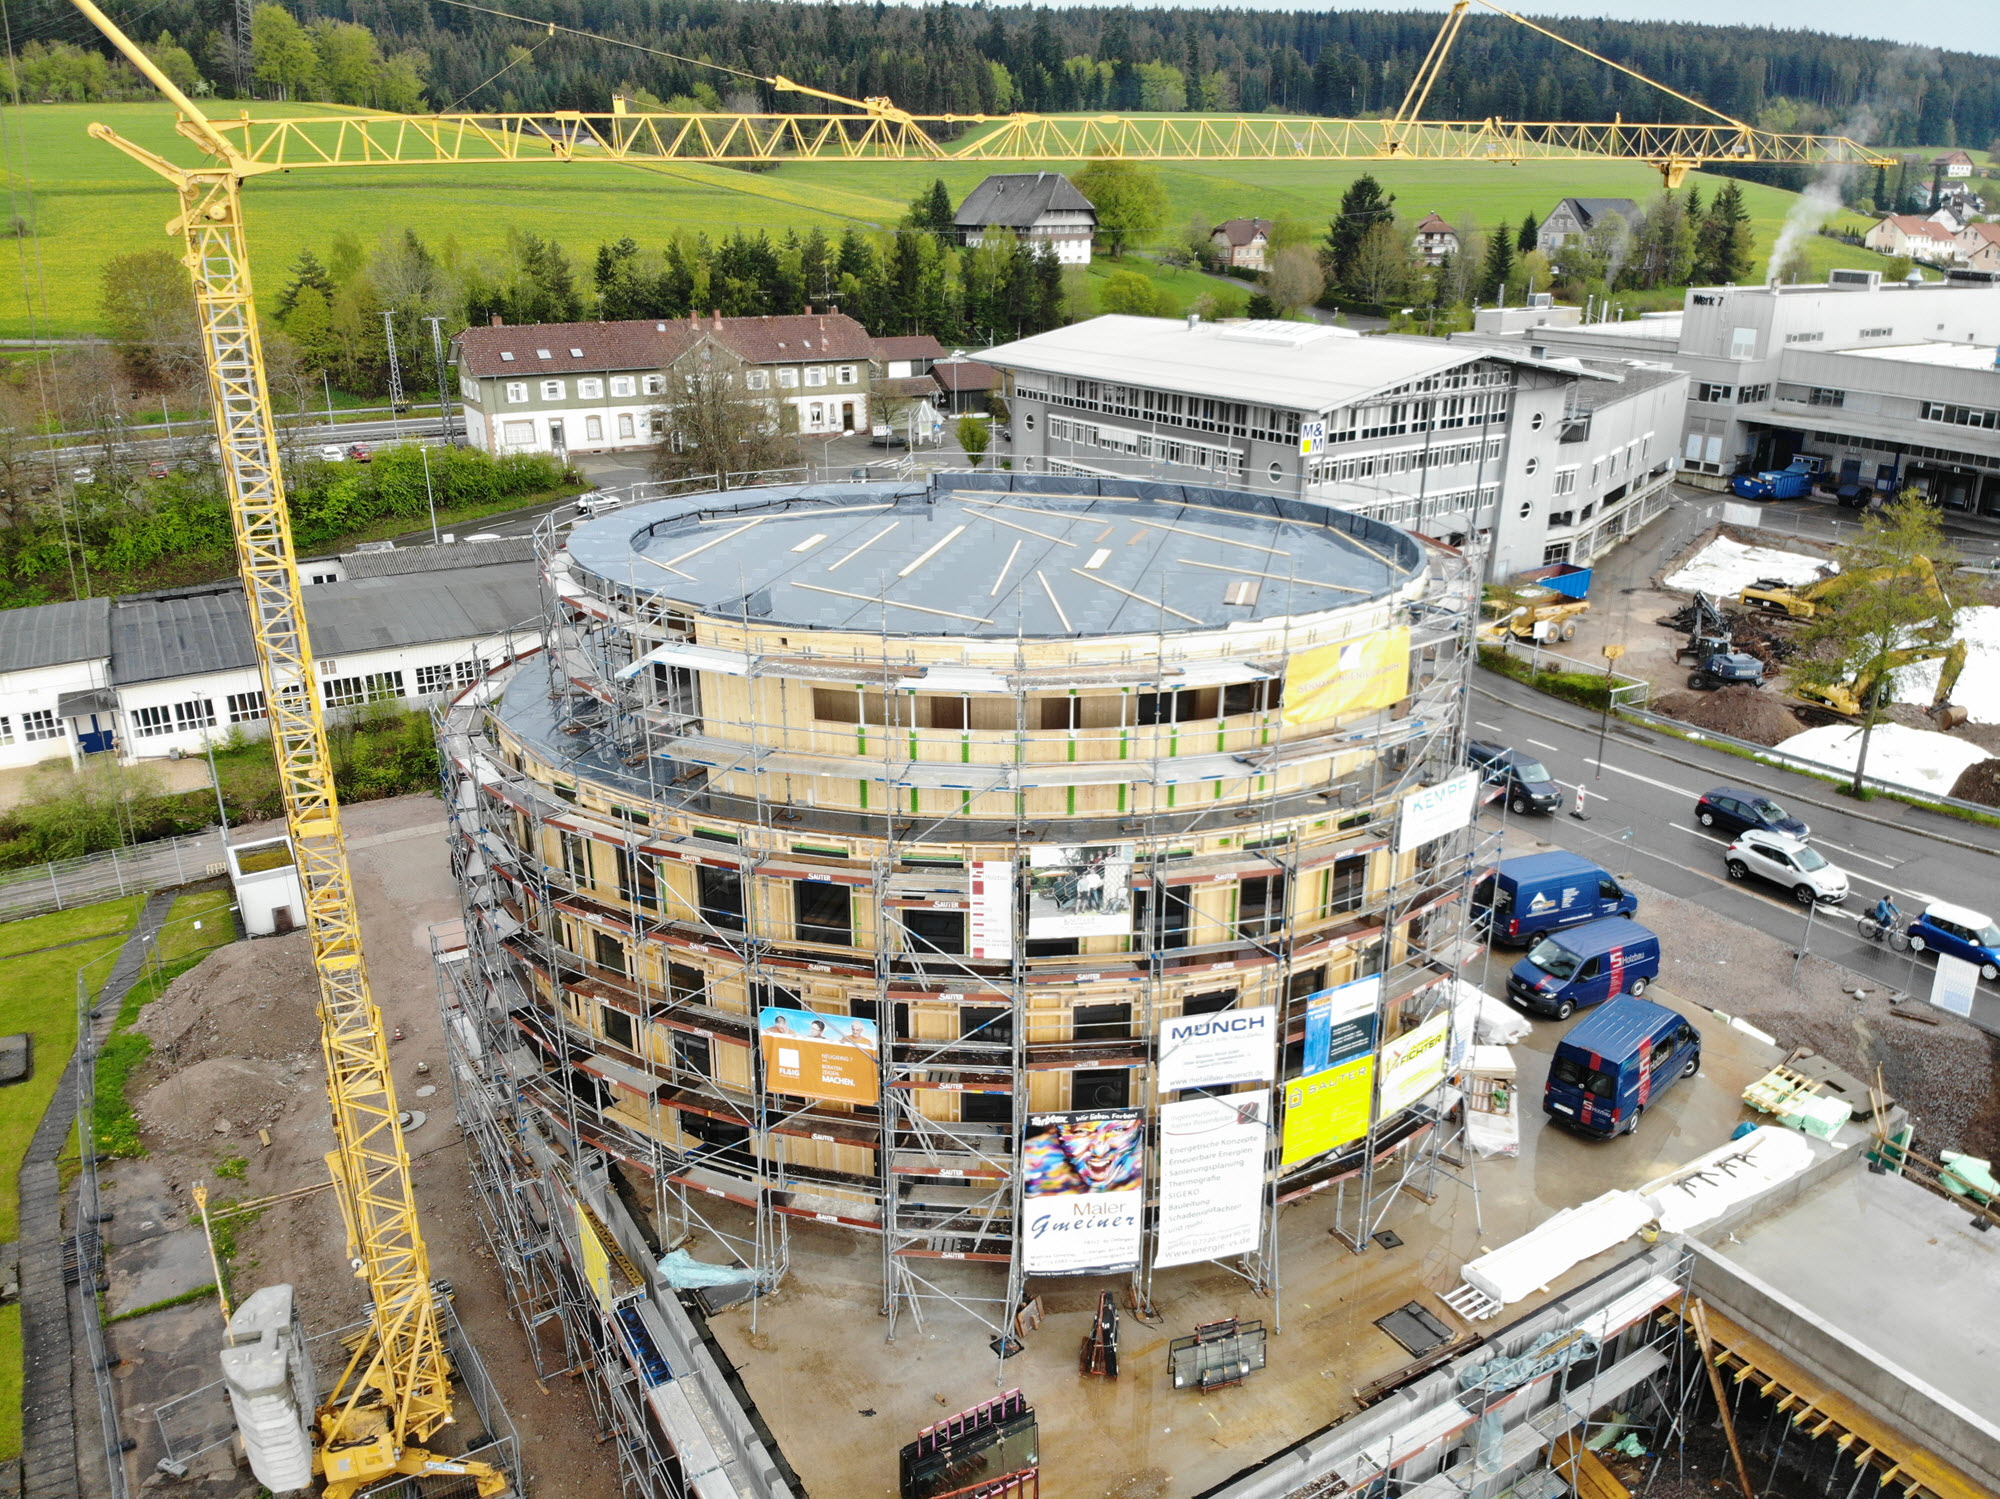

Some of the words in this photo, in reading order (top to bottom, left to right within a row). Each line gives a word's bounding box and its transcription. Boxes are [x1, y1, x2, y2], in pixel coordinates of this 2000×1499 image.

[1693, 294, 1715, 307] Werk
[1312, 438, 1323, 452] M
[681, 854, 701, 863] SAUTER
[808, 873, 831, 881] SAUTER
[689, 943, 709, 952] SAUTER
[1624, 952, 1645, 964] Holzbau
[809, 964, 831, 973] SAUTER
[1211, 962, 1234, 970] SAUTER
[1077, 973, 1100, 981] SAUTER
[1172, 1016, 1264, 1040] MÜNCH
[1400, 1034, 1442, 1066] FICHTER
[779, 1068, 800, 1077] FLAIG
[822, 1076, 856, 1086] MACHEN.
[1308, 1067, 1367, 1095] SAUTER
[1090, 1112, 1110, 1120] lieben
[1112, 1112, 1138, 1120] Farben!
[811, 1133, 834, 1141] SAUTER
[1169, 1139, 1220, 1155] Energetische
[1221, 1135, 1259, 1146] Konzepte
[1169, 1153, 1217, 1166] Erneuerbare
[1218, 1148, 1253, 1158] Energien
[1169, 1159, 1245, 1177] Sanierungsplanung
[1169, 1175, 1221, 1188] Thermografie
[1169, 1188, 1200, 1199] SIGEKO
[1073, 1202, 1126, 1216] Maler
[1169, 1199, 1210, 1211] Bauleitung
[816, 1214, 838, 1222] SAUTER
[1031, 1214, 1135, 1239] Gmeiner
